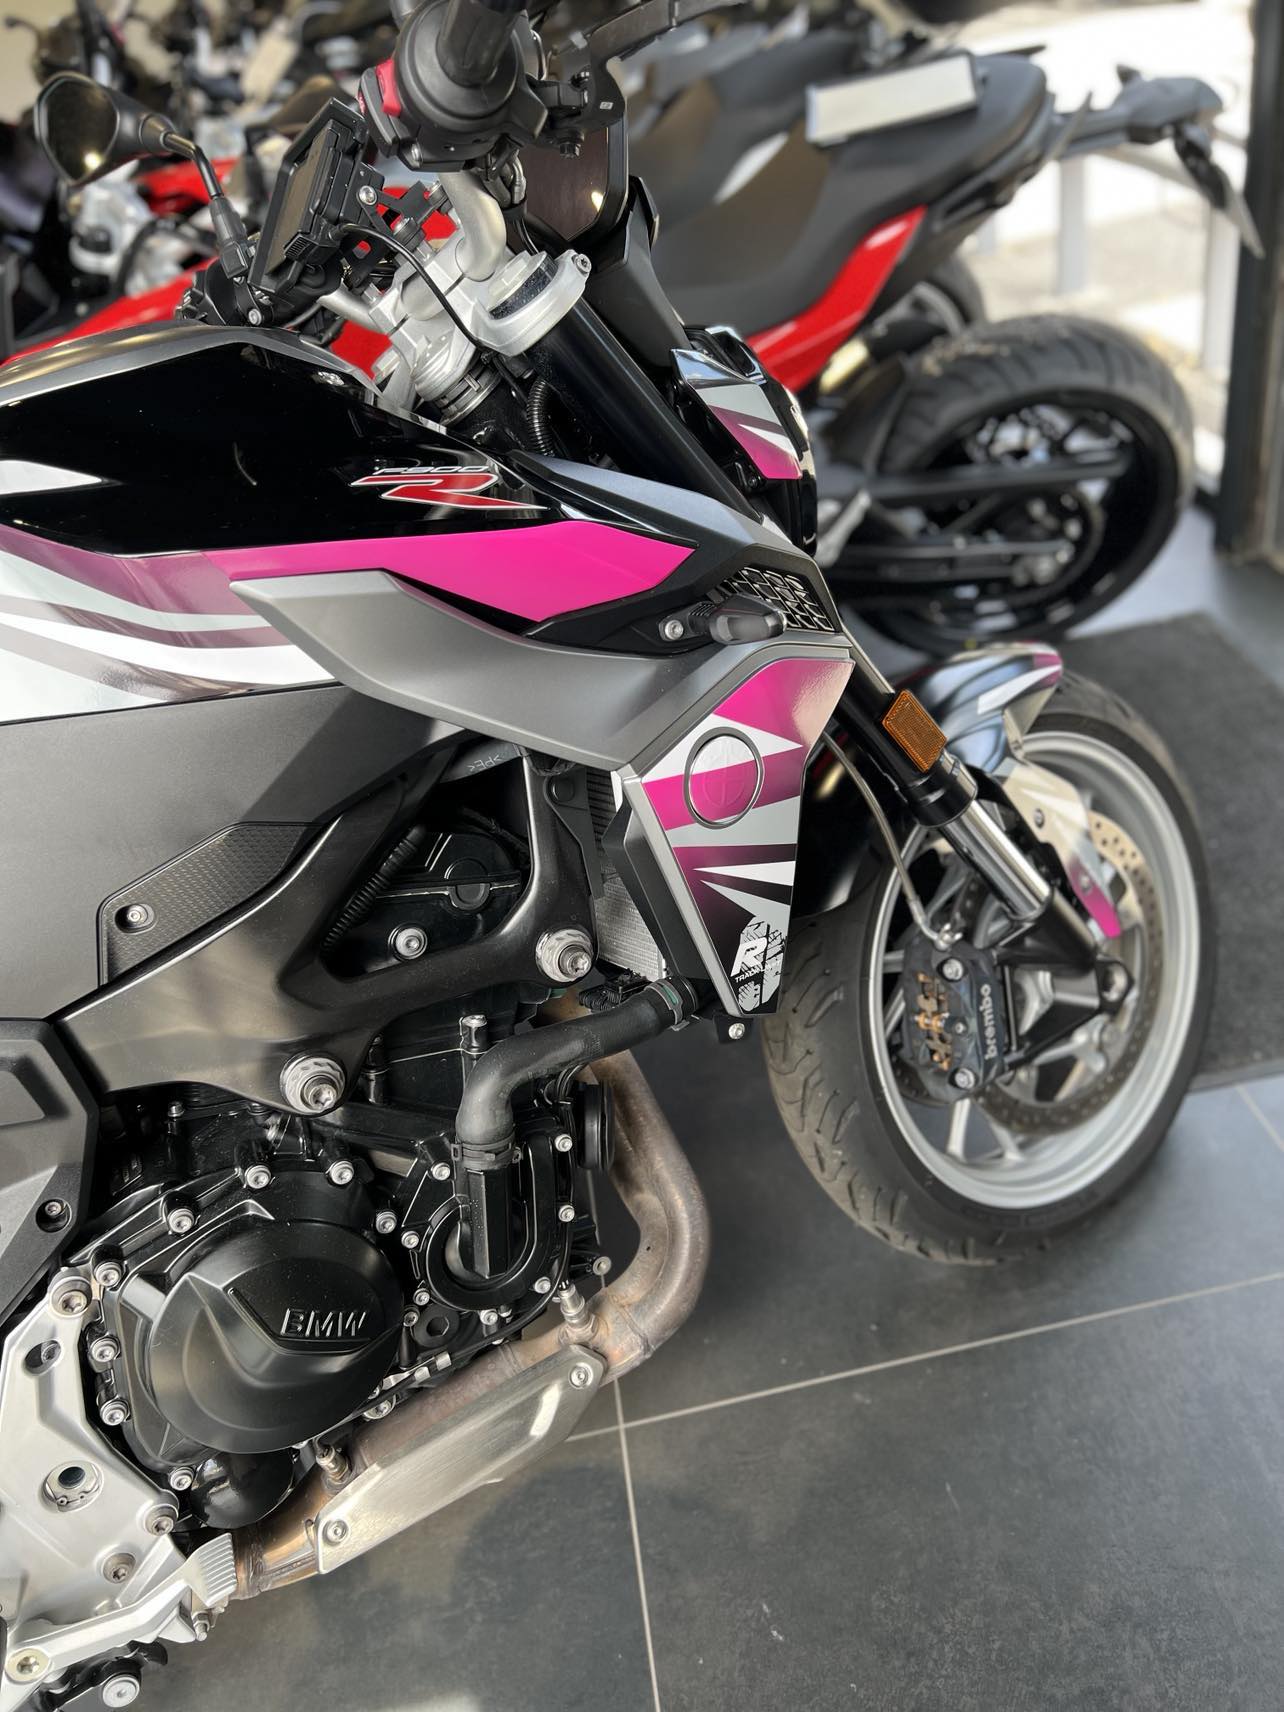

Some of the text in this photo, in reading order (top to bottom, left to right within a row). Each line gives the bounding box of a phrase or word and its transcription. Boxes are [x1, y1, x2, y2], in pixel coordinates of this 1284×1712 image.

[372, 465, 489, 476] F900
[349, 473, 548, 510] R
[979, 984, 998, 1060] brembo
[280, 1307, 367, 1338] BMW
